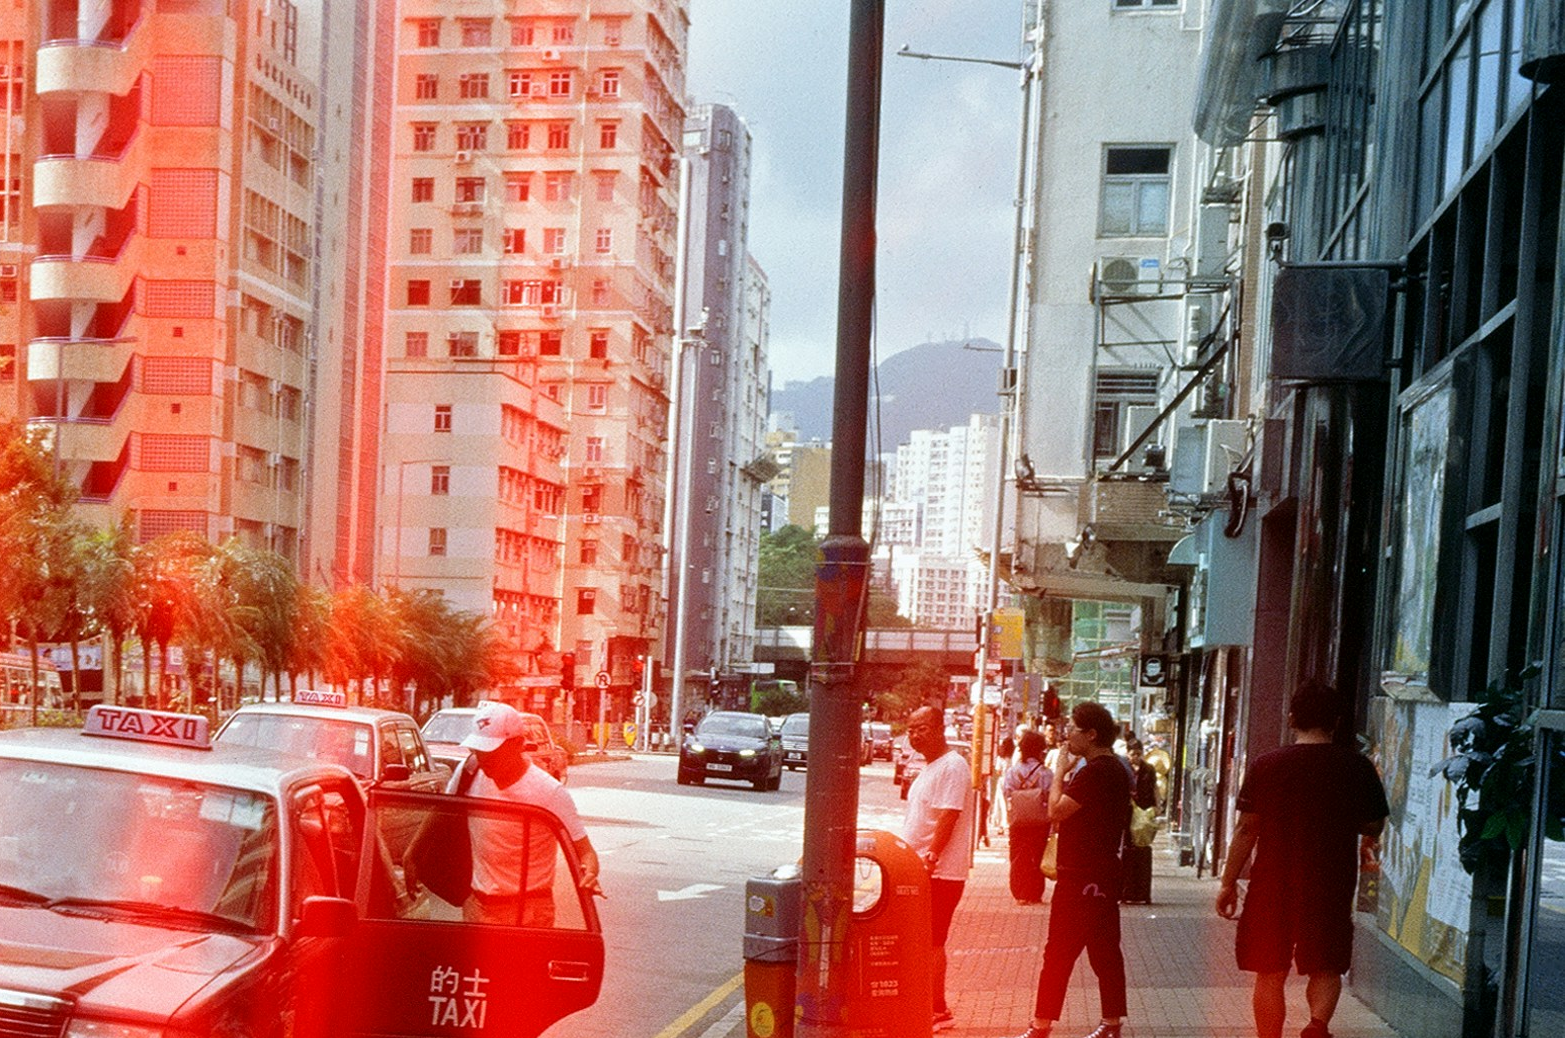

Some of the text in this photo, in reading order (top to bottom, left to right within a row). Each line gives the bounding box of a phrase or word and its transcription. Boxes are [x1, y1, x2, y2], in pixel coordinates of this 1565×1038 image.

[299, 690, 342, 705] TAXI
[96, 708, 198, 741] TAXI
[429, 964, 491, 998] 的士
[428, 995, 488, 1030] TAXI
